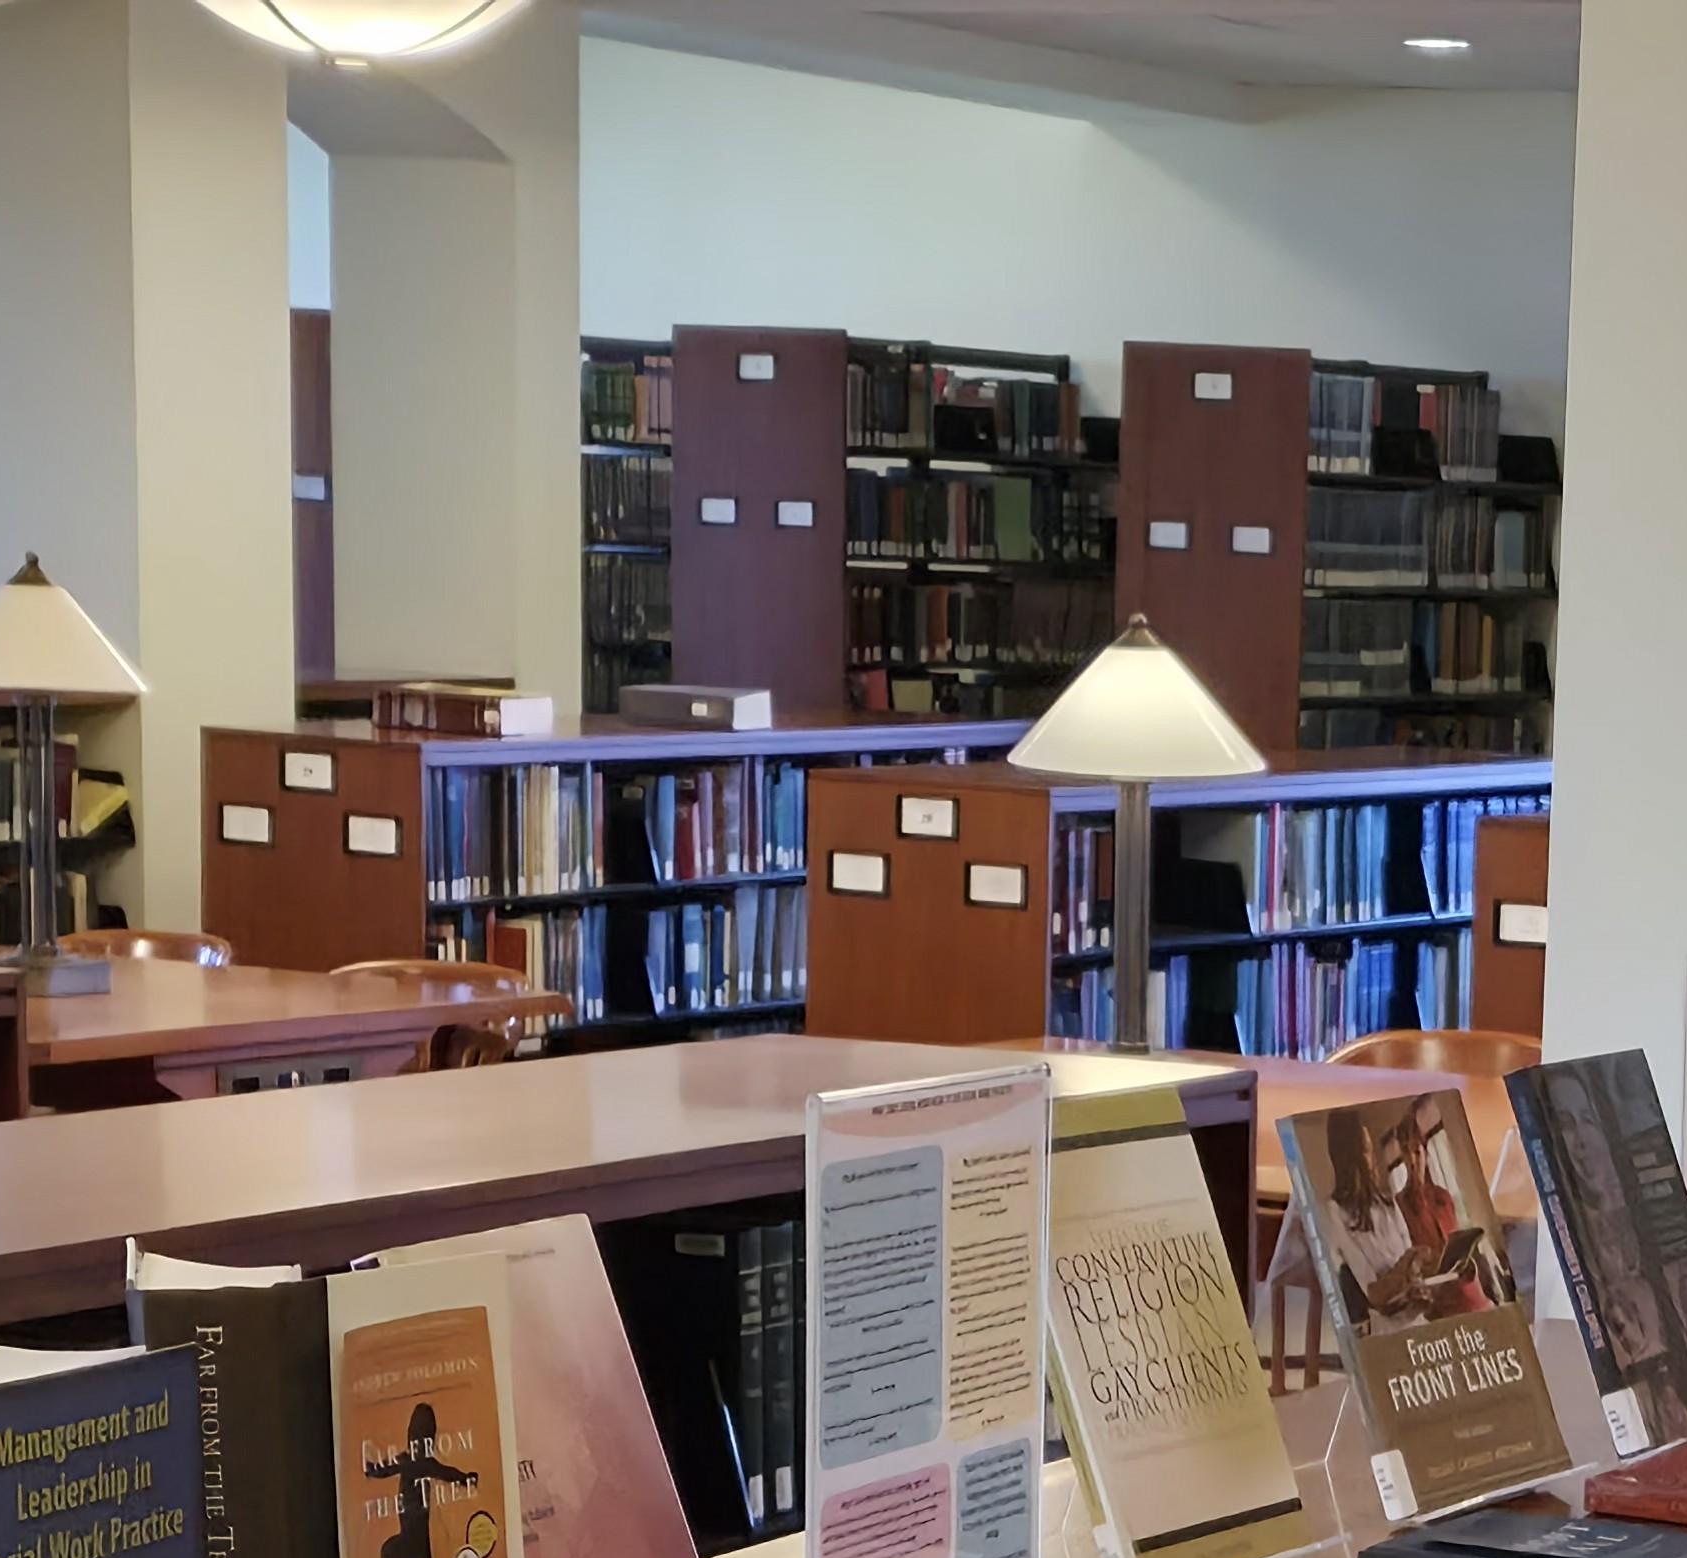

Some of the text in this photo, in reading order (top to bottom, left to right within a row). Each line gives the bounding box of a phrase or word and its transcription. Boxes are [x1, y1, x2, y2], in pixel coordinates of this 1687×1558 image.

[1056, 1230, 1212, 1285] CONSERVATIVE
[1064, 1260, 1226, 1326] RELIGION
[1090, 1342, 1249, 1405] GAY CLIENTS
[1406, 1324, 1487, 1367] From the
[134, 1387, 169, 1430] and
[1388, 1347, 1524, 1413] FRONT LINES
[199, 1386, 221, 1458] FROM
[17, 1455, 152, 1521] Leadership in
[204, 1463, 224, 1520] THE
[414, 1476, 479, 1510] TREE
[110, 1506, 184, 1553] Practice
